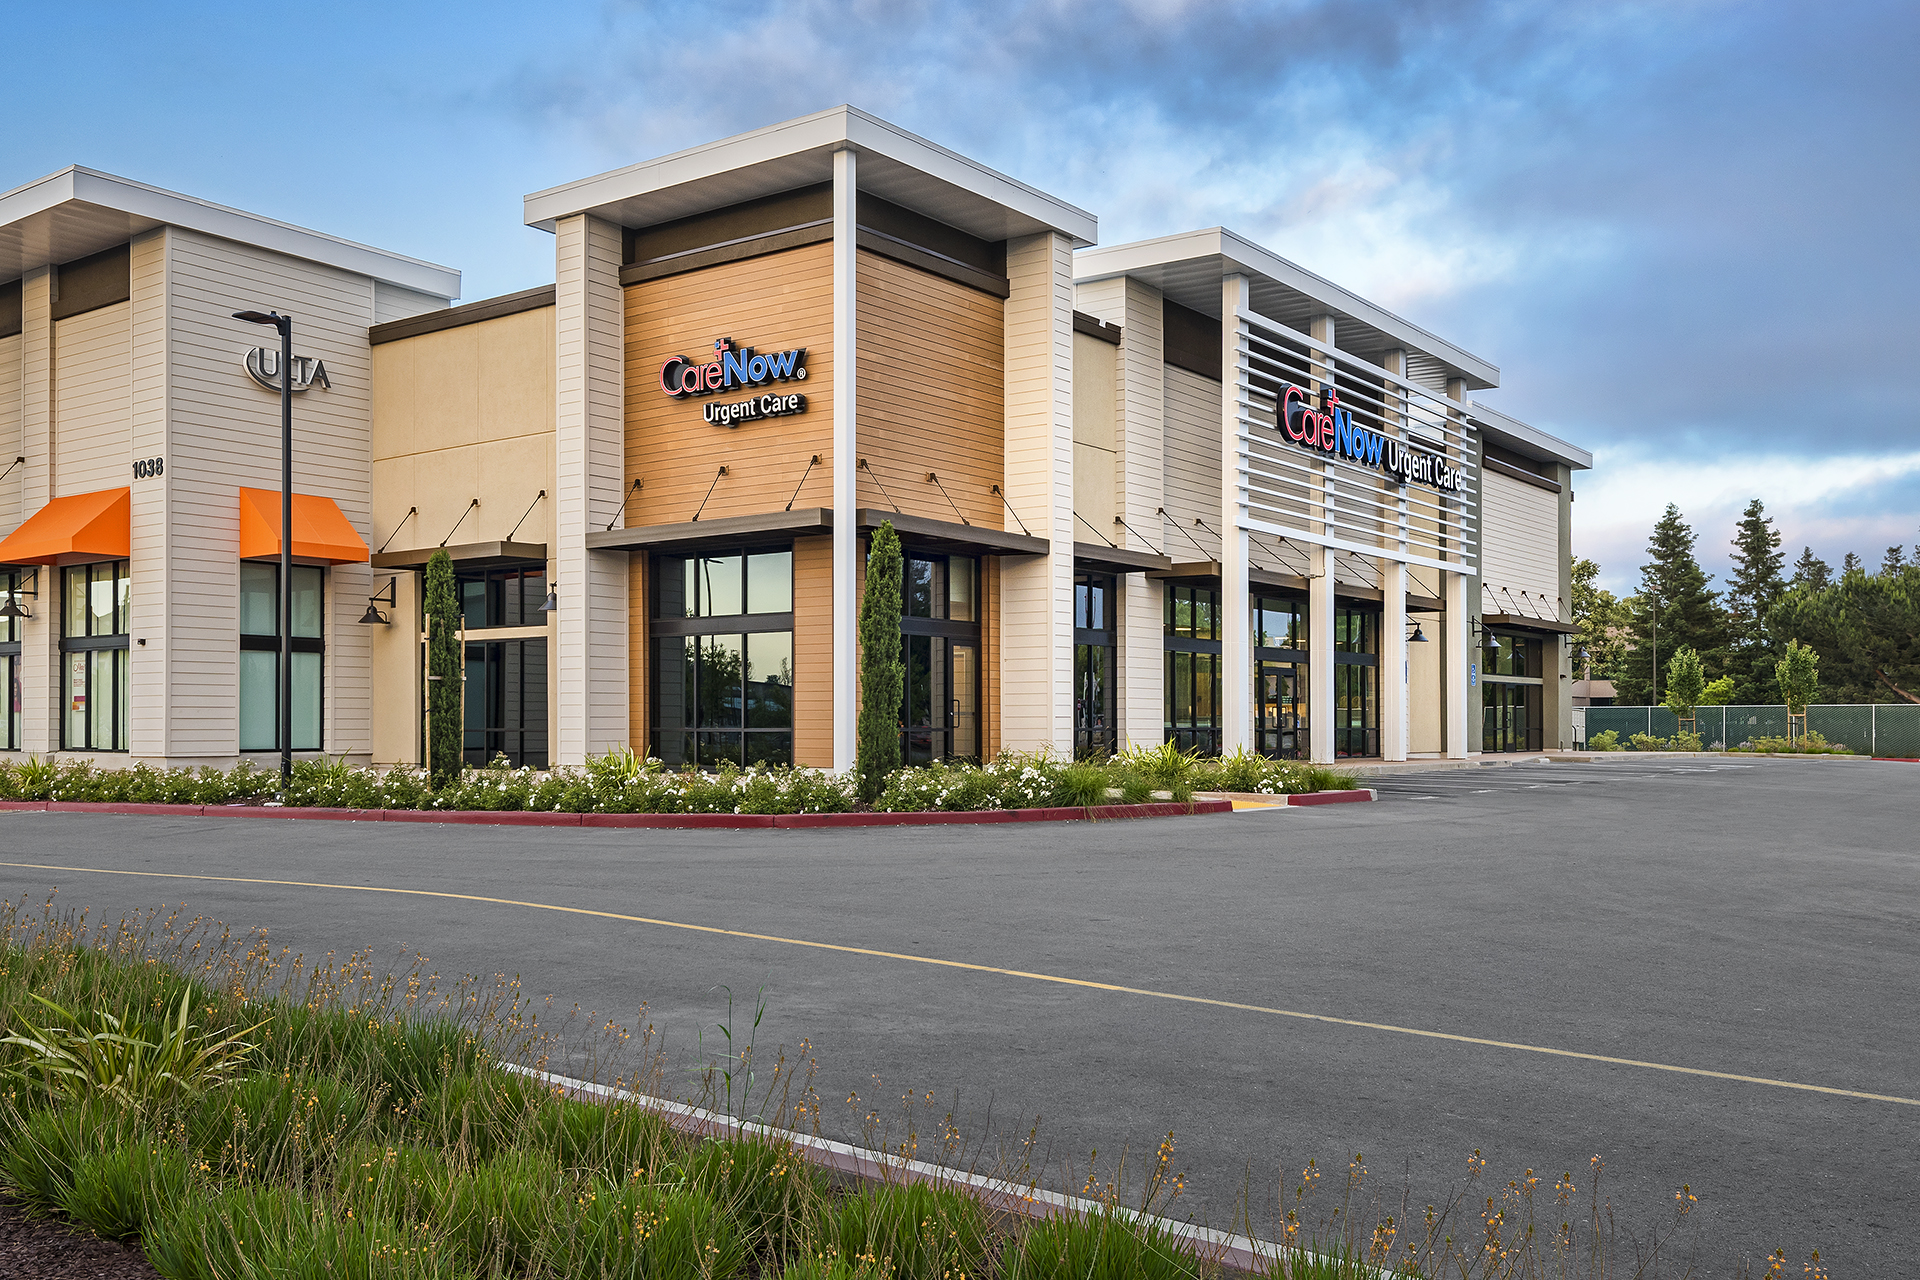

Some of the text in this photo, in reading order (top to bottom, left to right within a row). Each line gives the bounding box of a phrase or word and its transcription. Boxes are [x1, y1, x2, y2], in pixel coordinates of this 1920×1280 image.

[256, 347, 331, 390] UTA
[703, 394, 798, 425] Urgent Care
[132, 457, 164, 480] 1038
[1388, 440, 1432, 484] Urgent
[1435, 456, 1462, 492] Care
